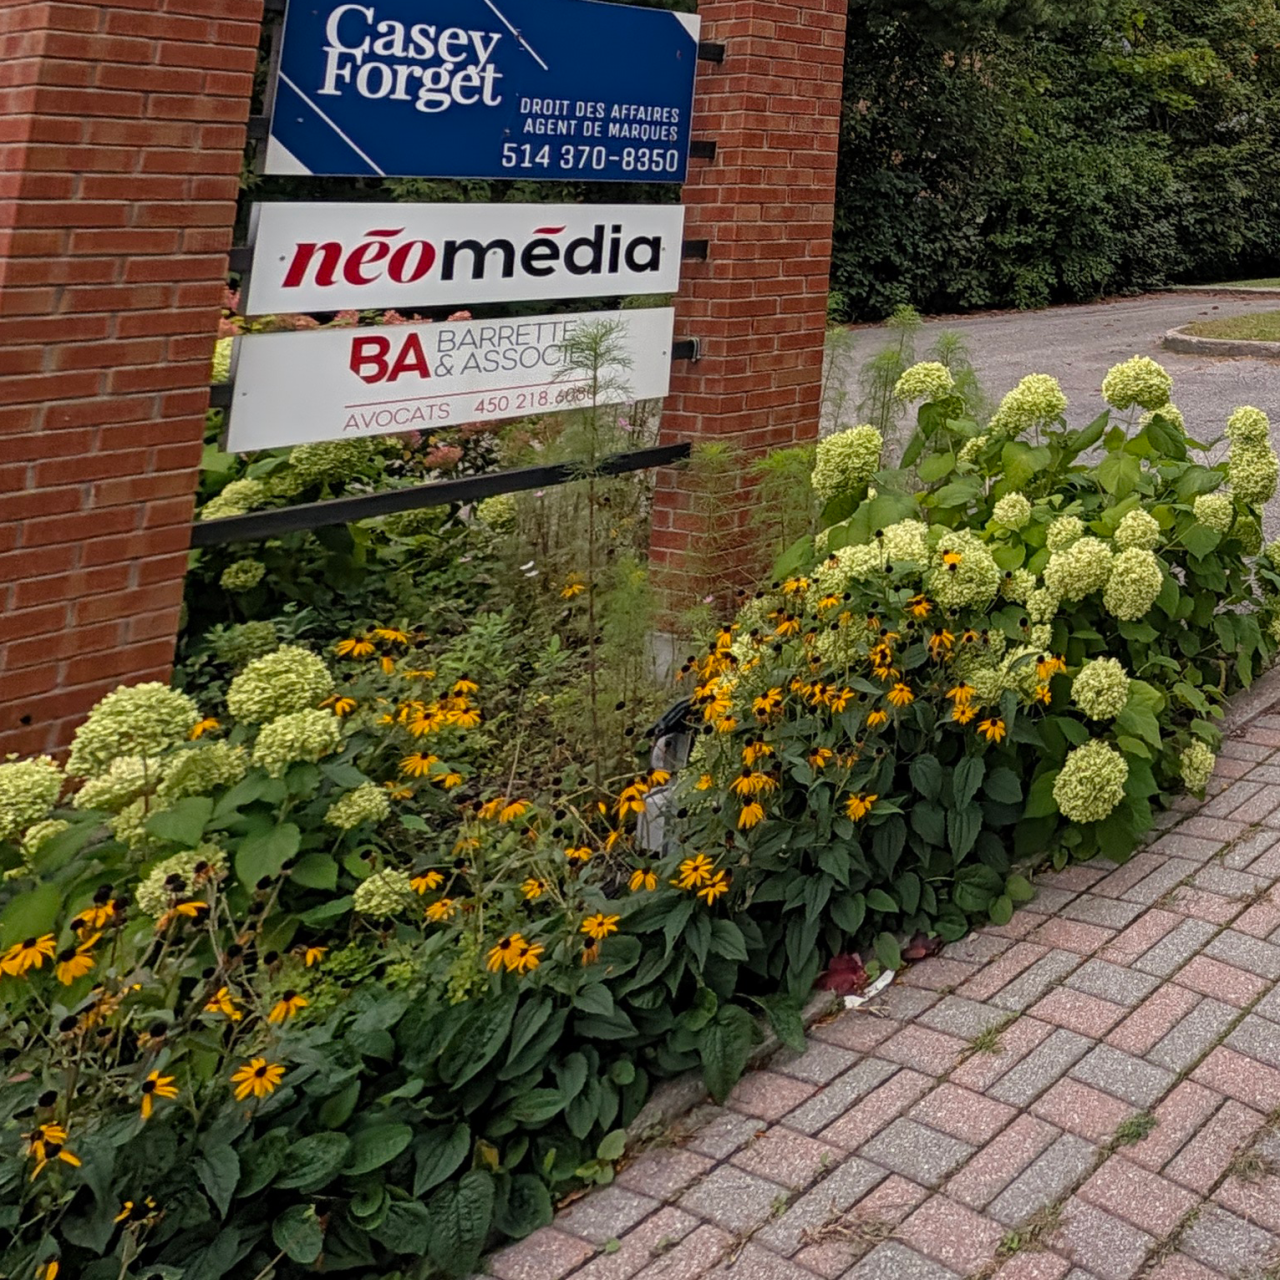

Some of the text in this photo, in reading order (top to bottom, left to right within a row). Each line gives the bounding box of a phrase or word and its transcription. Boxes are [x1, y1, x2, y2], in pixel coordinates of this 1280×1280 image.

[325, 4, 502, 72] Casey
[317, 46, 503, 113] Forget
[520, 98, 680, 124] DROIT DES AFFAIRES
[523, 118, 678, 142] AGENT DE MARQUES
[502, 143, 678, 172] 514 370-8350
[350, 320, 578, 384] BA BARRETTE
[434, 354, 454, 377] &
[343, 403, 450, 431] AVOCATS
[474, 396, 509, 414] 450
